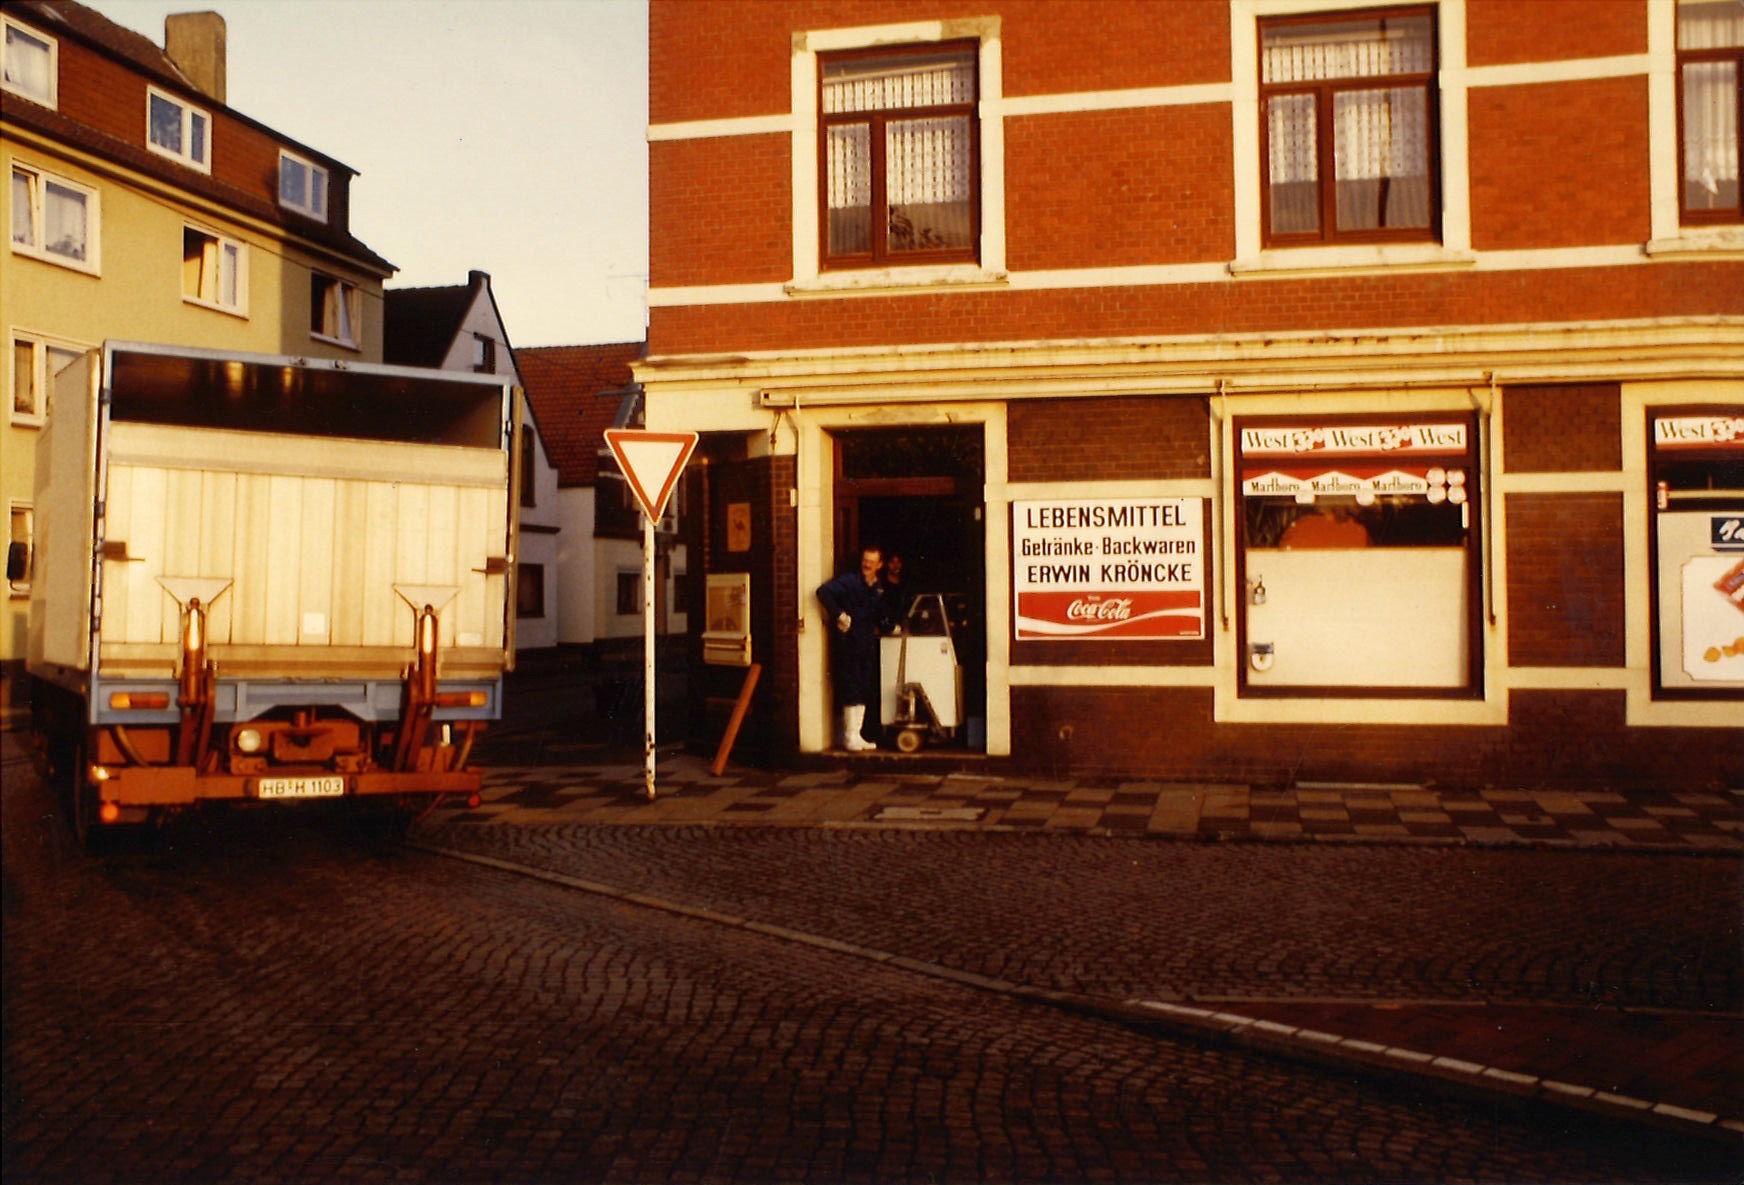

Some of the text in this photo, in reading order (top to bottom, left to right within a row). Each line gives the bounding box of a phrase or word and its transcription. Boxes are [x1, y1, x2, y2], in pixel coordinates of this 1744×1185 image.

[1246, 428, 1463, 448] West West West
[1661, 421, 1704, 438] West
[1251, 475, 1423, 492] Marlboro Marlboro Marlboro
[1026, 505, 1187, 529] LEBENSMITTEL
[1022, 536, 1196, 556] Getränke Backwaren
[1027, 560, 1192, 583] ERWIN KRÖNCKE
